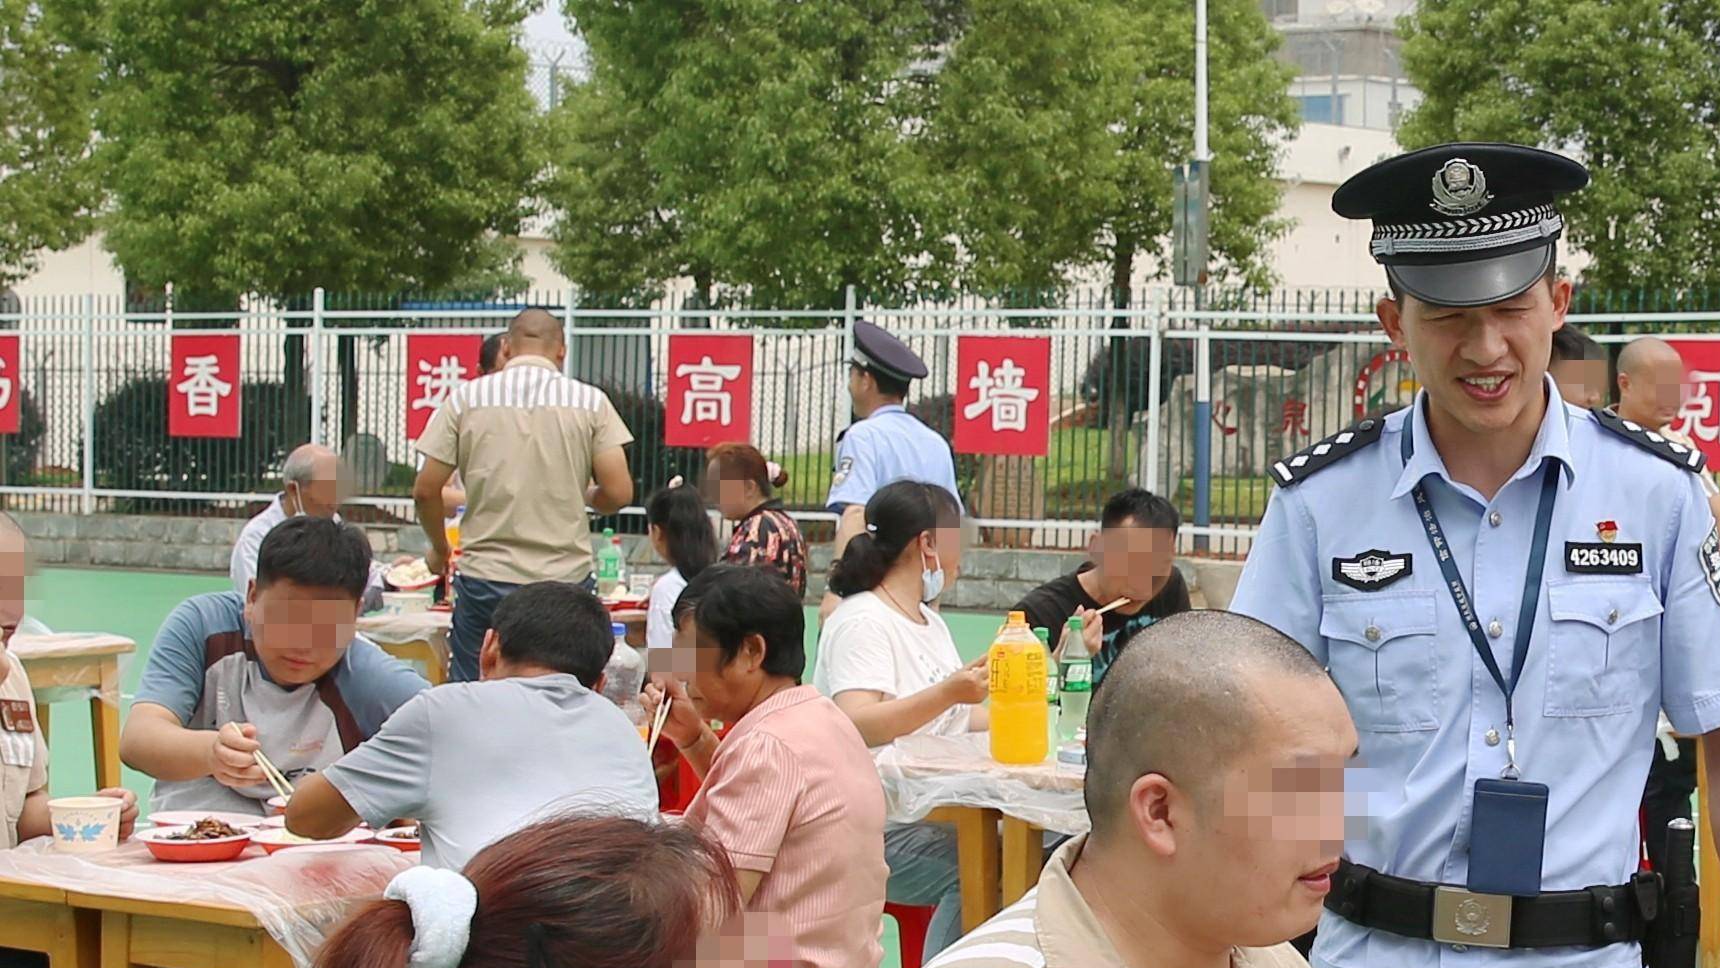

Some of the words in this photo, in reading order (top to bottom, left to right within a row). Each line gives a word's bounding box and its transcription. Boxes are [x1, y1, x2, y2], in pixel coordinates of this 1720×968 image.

[175, 353, 233, 417] 香
[411, 354, 468, 410] 进
[675, 355, 742, 427] 高
[963, 357, 1040, 432] 墙
[1570, 548, 1638, 567] 4263409
